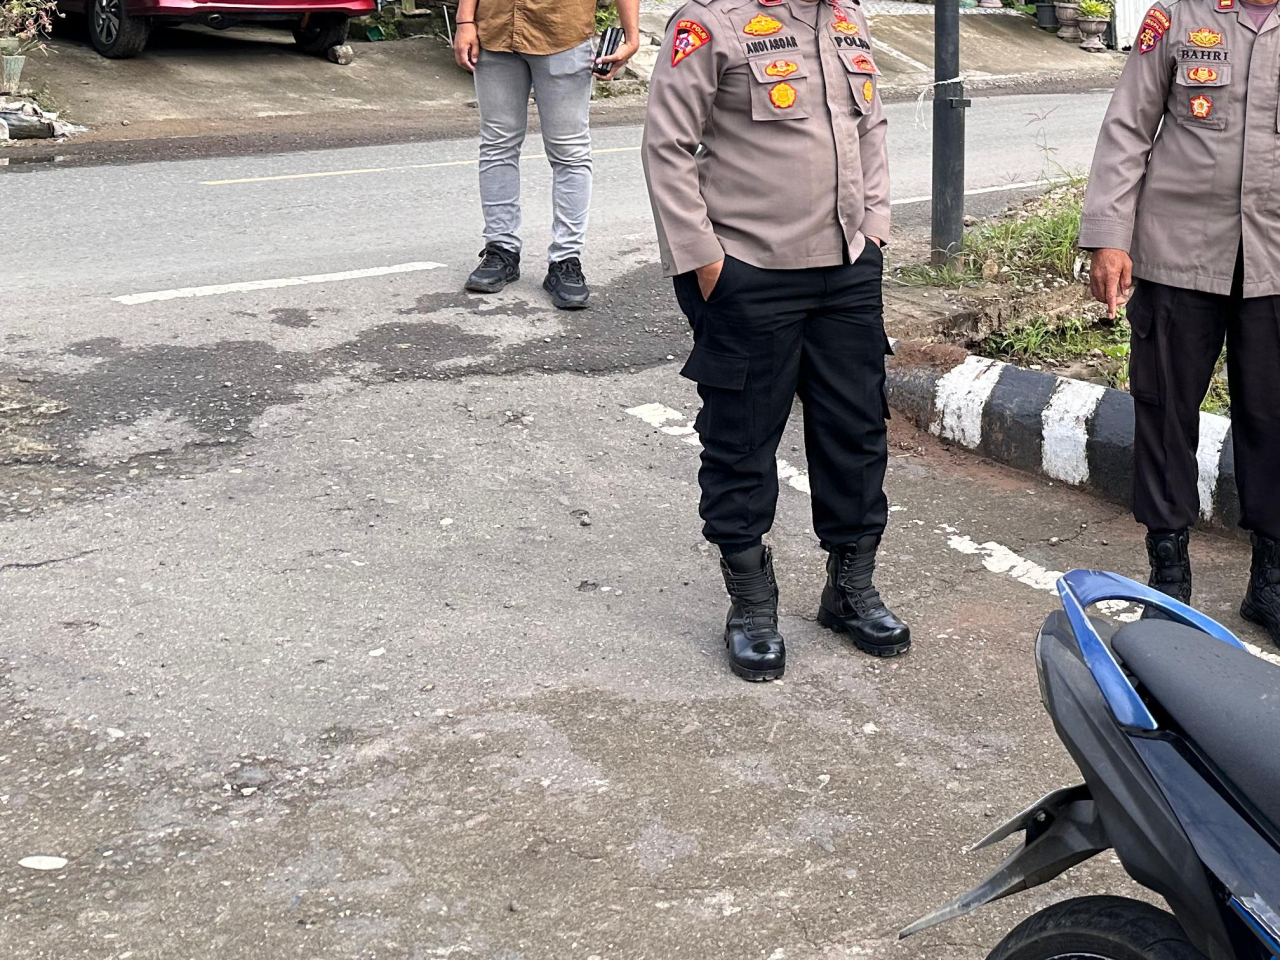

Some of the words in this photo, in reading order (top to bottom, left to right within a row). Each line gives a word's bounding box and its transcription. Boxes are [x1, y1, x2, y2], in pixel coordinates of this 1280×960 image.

[692, 24, 708, 39] POLRI
[745, 40, 768, 54] ANDI
[769, 36, 798, 51] ASDAR
[1181, 49, 1229, 62] BAHRI
